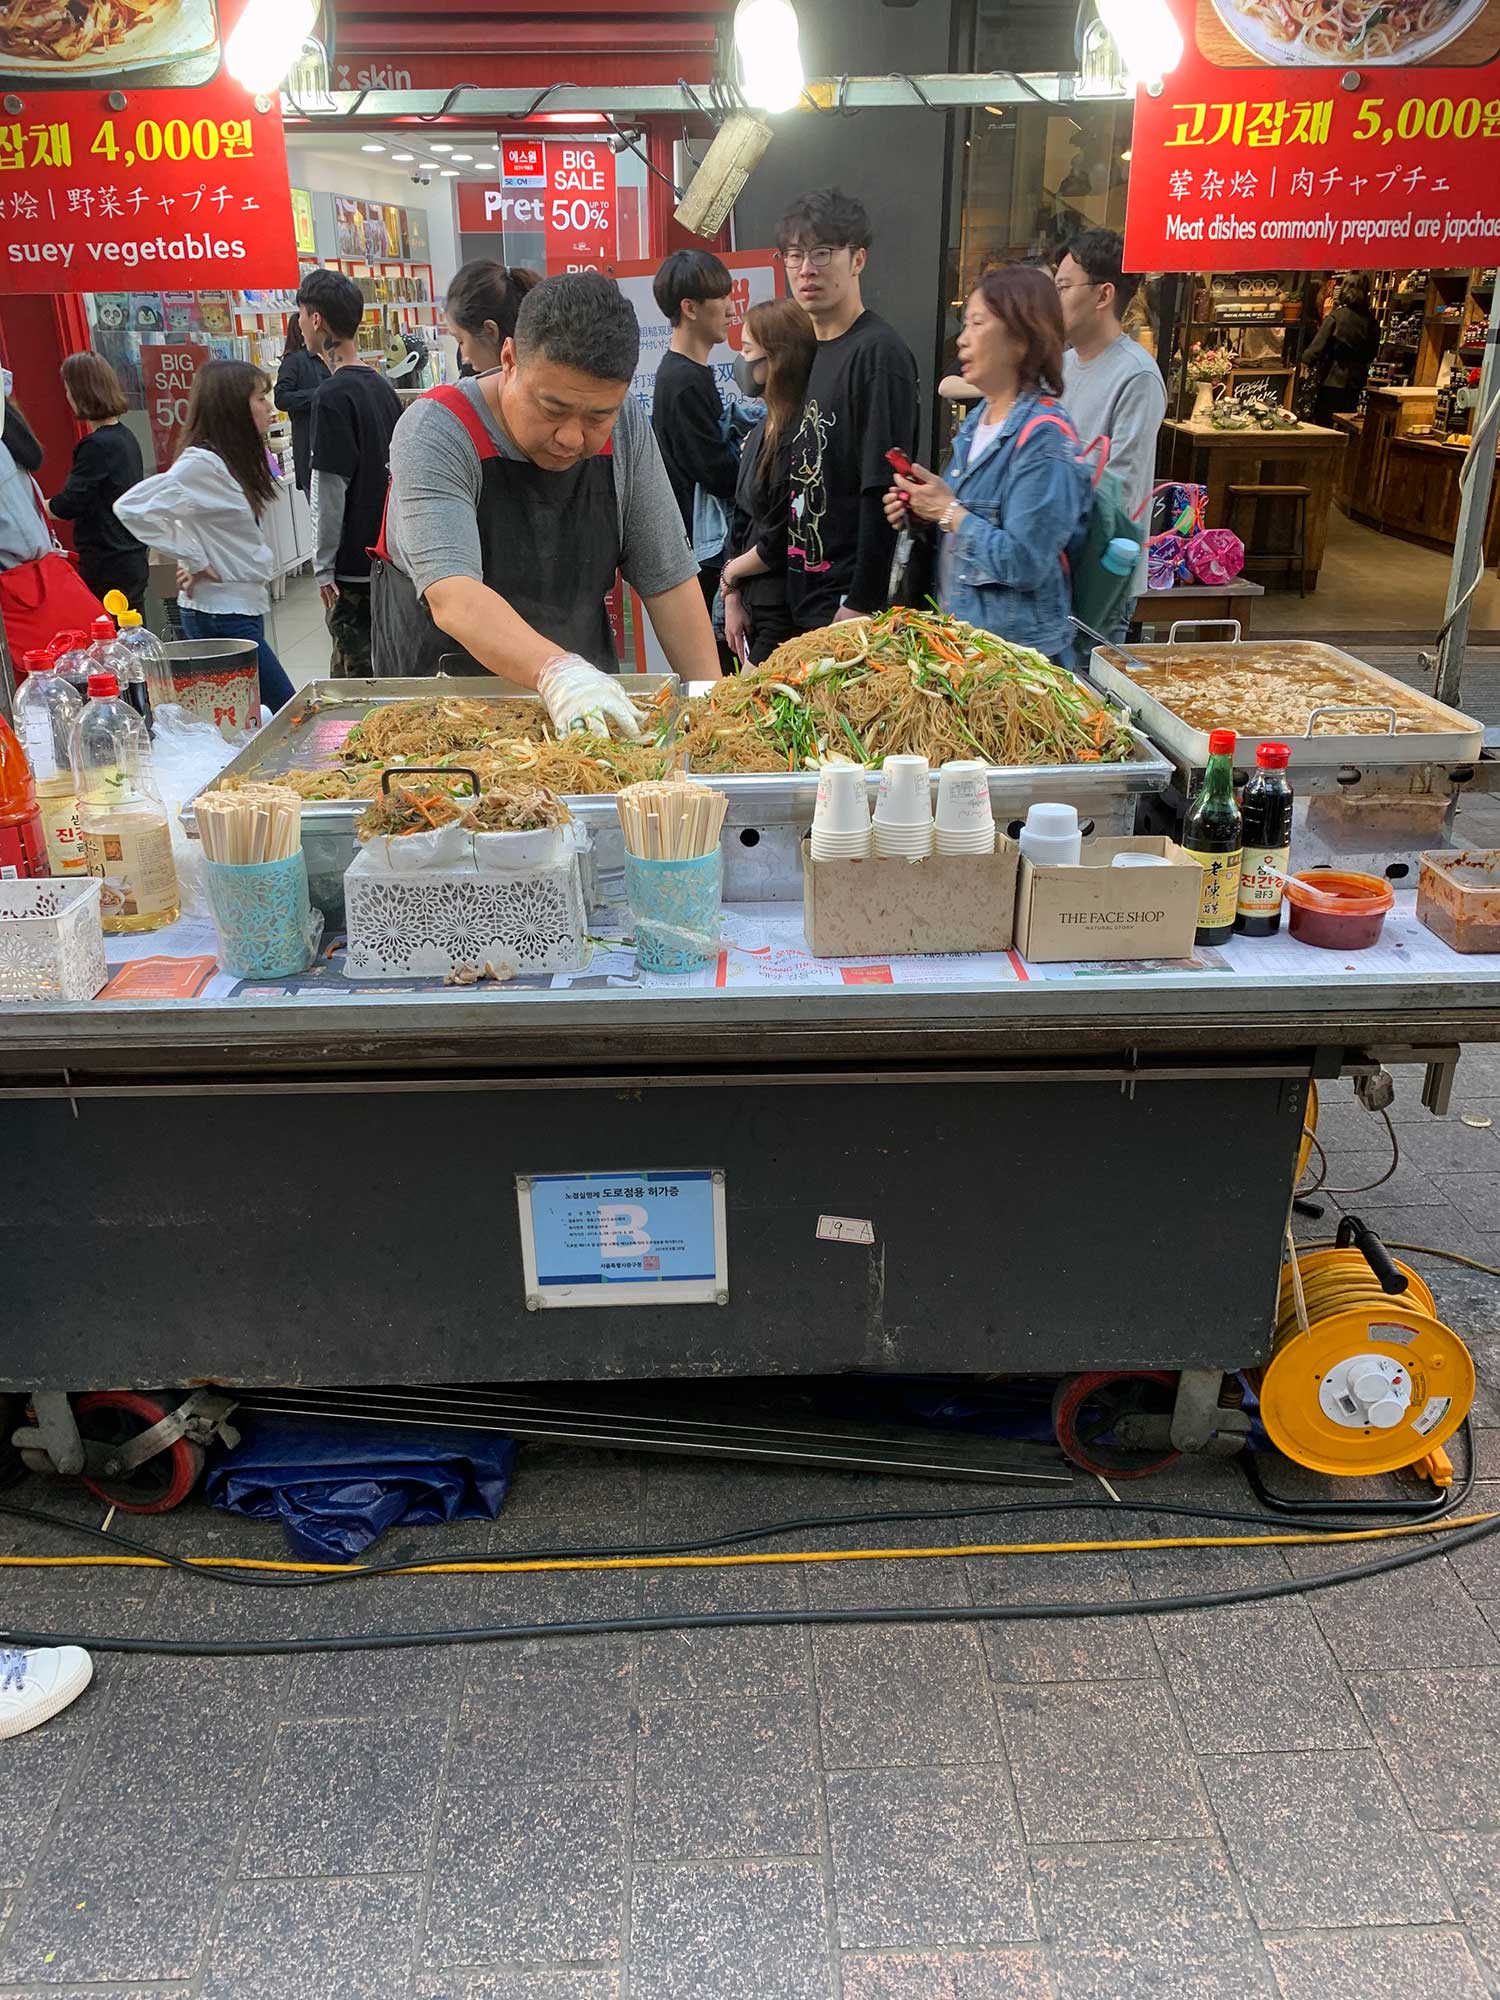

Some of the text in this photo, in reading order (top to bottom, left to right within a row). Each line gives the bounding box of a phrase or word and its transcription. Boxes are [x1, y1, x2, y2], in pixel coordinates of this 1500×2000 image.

[357, 64, 412, 90] skin
[1163, 100, 1334, 147] 고기잡채
[91, 119, 254, 168] 4,000원
[562, 150, 596, 170] BIG
[553, 171, 606, 190] SALE
[1165, 210, 1500, 245] Meat dishes commonly prepared are japchae
[8, 233, 247, 268] suey vegetables
[160, 354, 193, 371] BIG
[154, 372, 197, 390] SAL
[1058, 910, 1165, 924] THE FACE SHOP
[647, 1186, 680, 1198] 허가증
[599, 1204, 652, 1259] B
